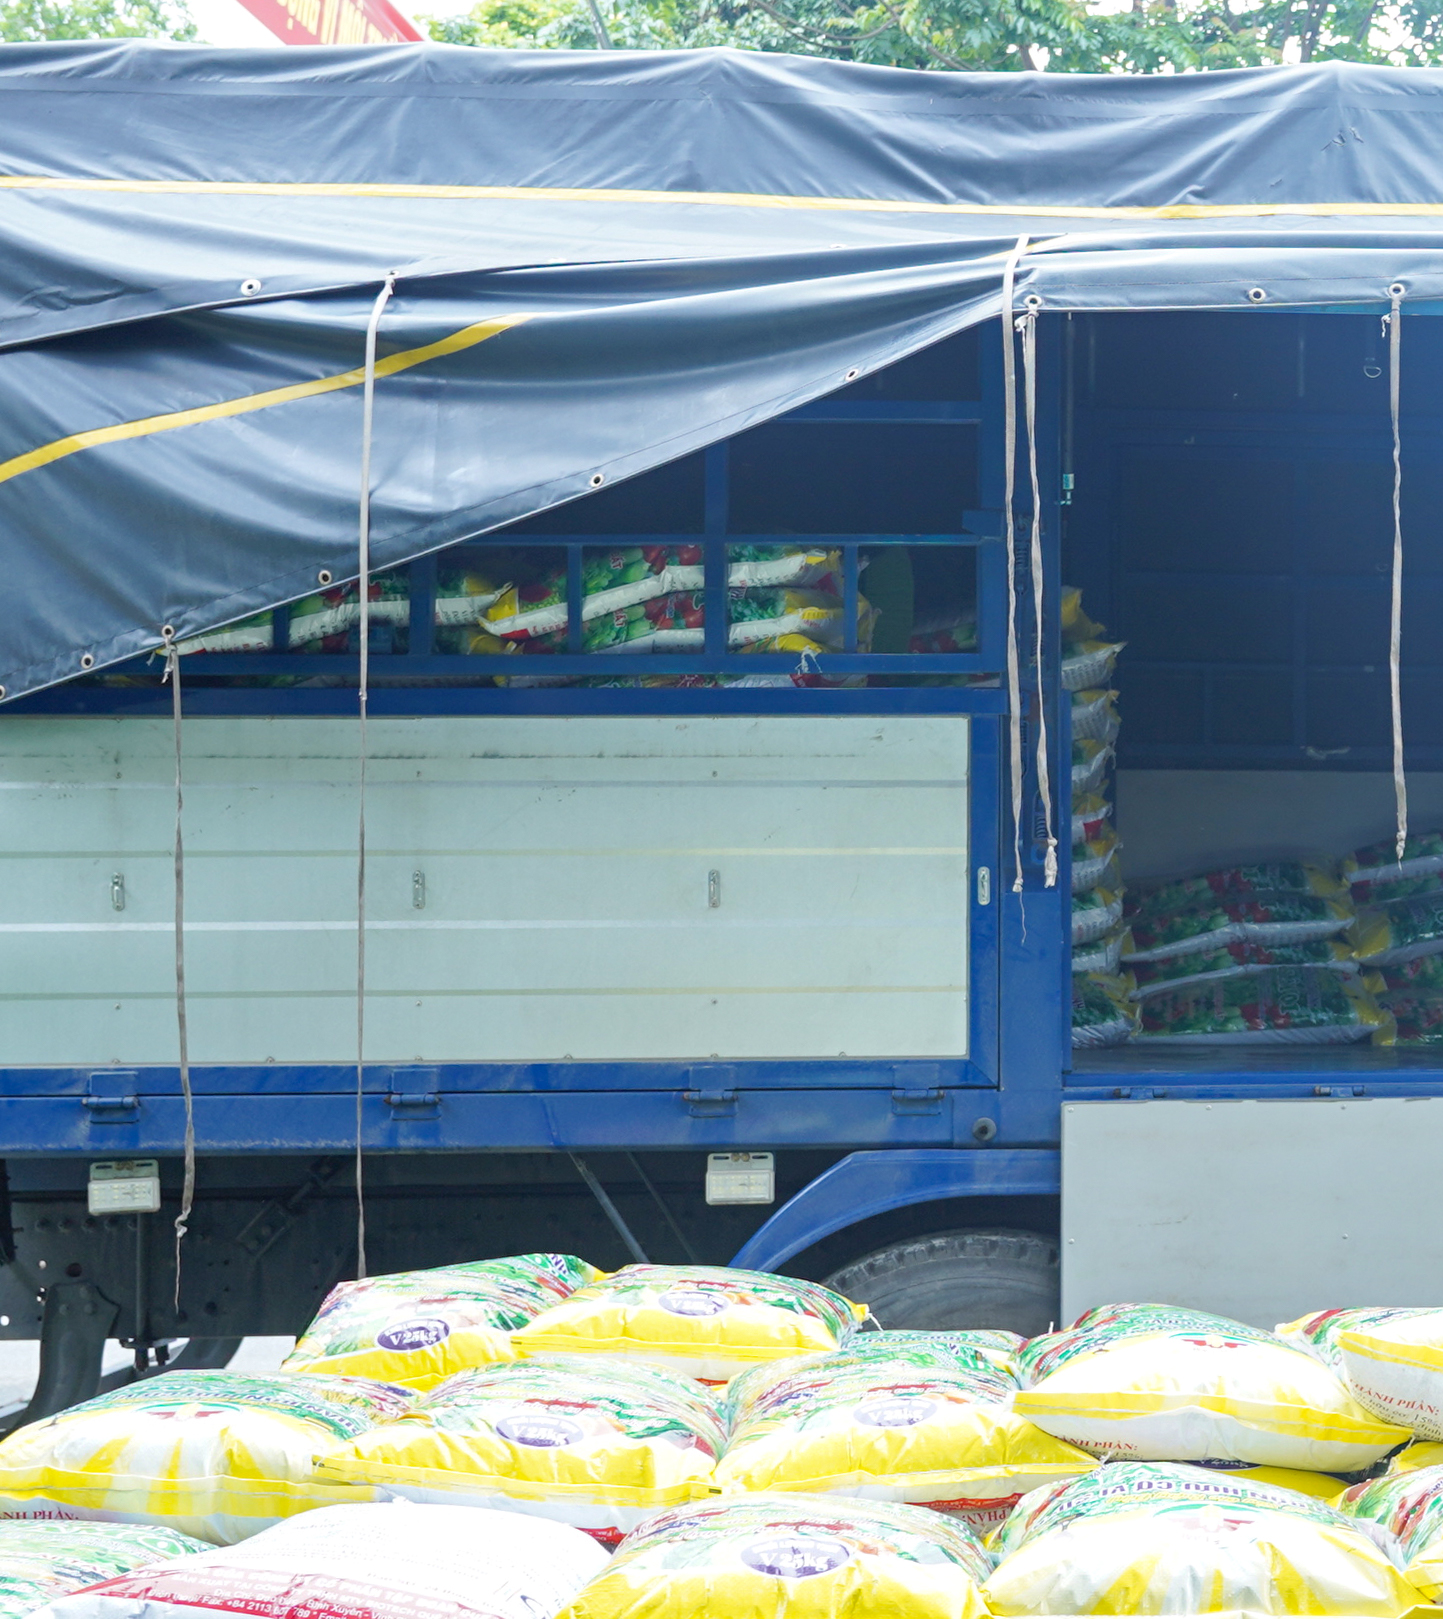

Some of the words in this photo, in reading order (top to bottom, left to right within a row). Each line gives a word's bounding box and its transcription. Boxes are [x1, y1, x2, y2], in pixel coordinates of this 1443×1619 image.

[779, 1552, 830, 1572] 25kg
[226, 1598, 246, 1610] +84
[247, 1600, 272, 1613] 2113
